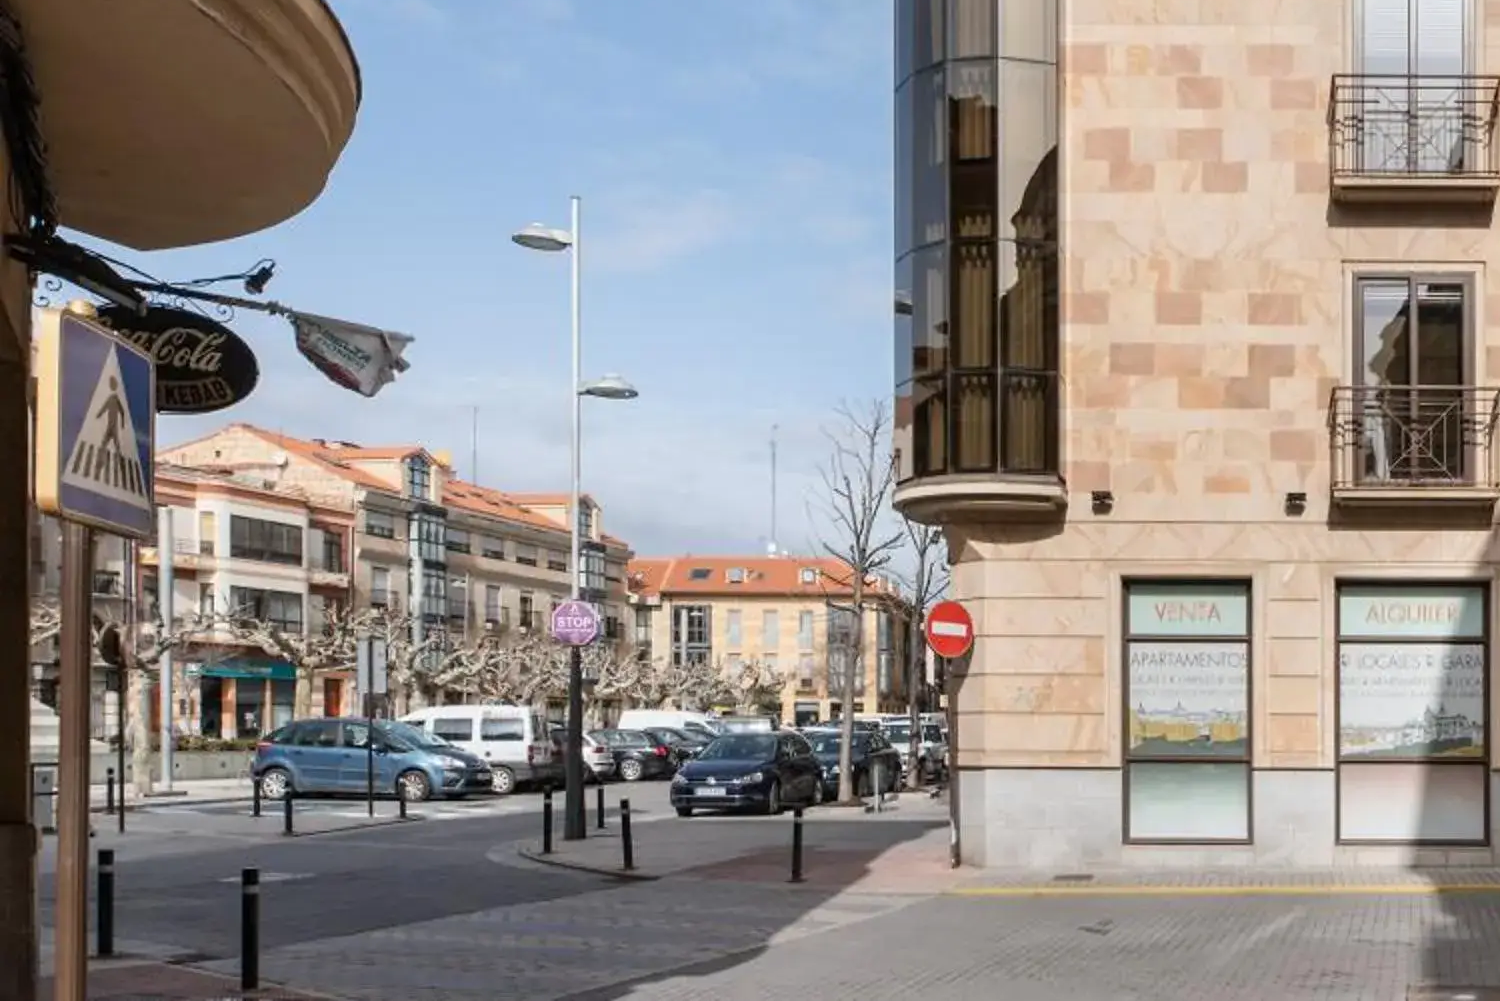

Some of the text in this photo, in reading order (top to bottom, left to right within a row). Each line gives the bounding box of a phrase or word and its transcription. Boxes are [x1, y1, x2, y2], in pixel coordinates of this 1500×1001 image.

[163, 378, 229, 406] KEBAB
[556, 615, 592, 628] STOP
[1154, 601, 1222, 623] VENTA
[1364, 601, 1460, 625] ALQUILER
